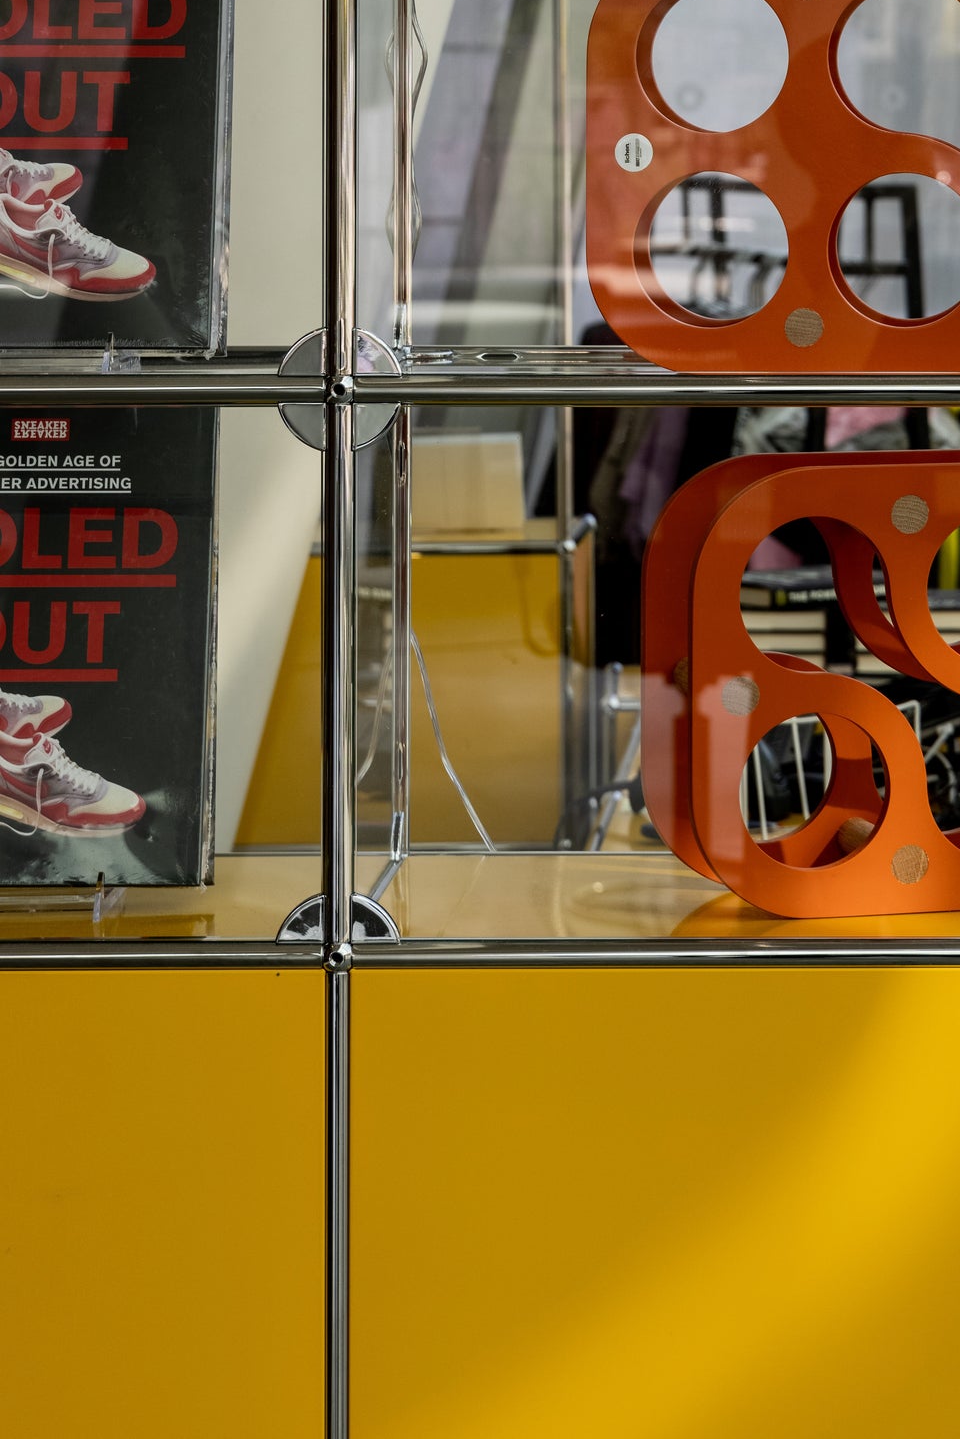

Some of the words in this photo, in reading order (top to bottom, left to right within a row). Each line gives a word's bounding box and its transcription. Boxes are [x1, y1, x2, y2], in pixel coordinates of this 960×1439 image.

[0, 70, 131, 133] UT
[14, 420, 67, 429] SNEAKER
[62, 455, 95, 467] AGE
[99, 455, 121, 467] OF
[26, 477, 132, 490] ADVERTISING
[0, 507, 179, 569] LED
[0, 601, 121, 665] UT
